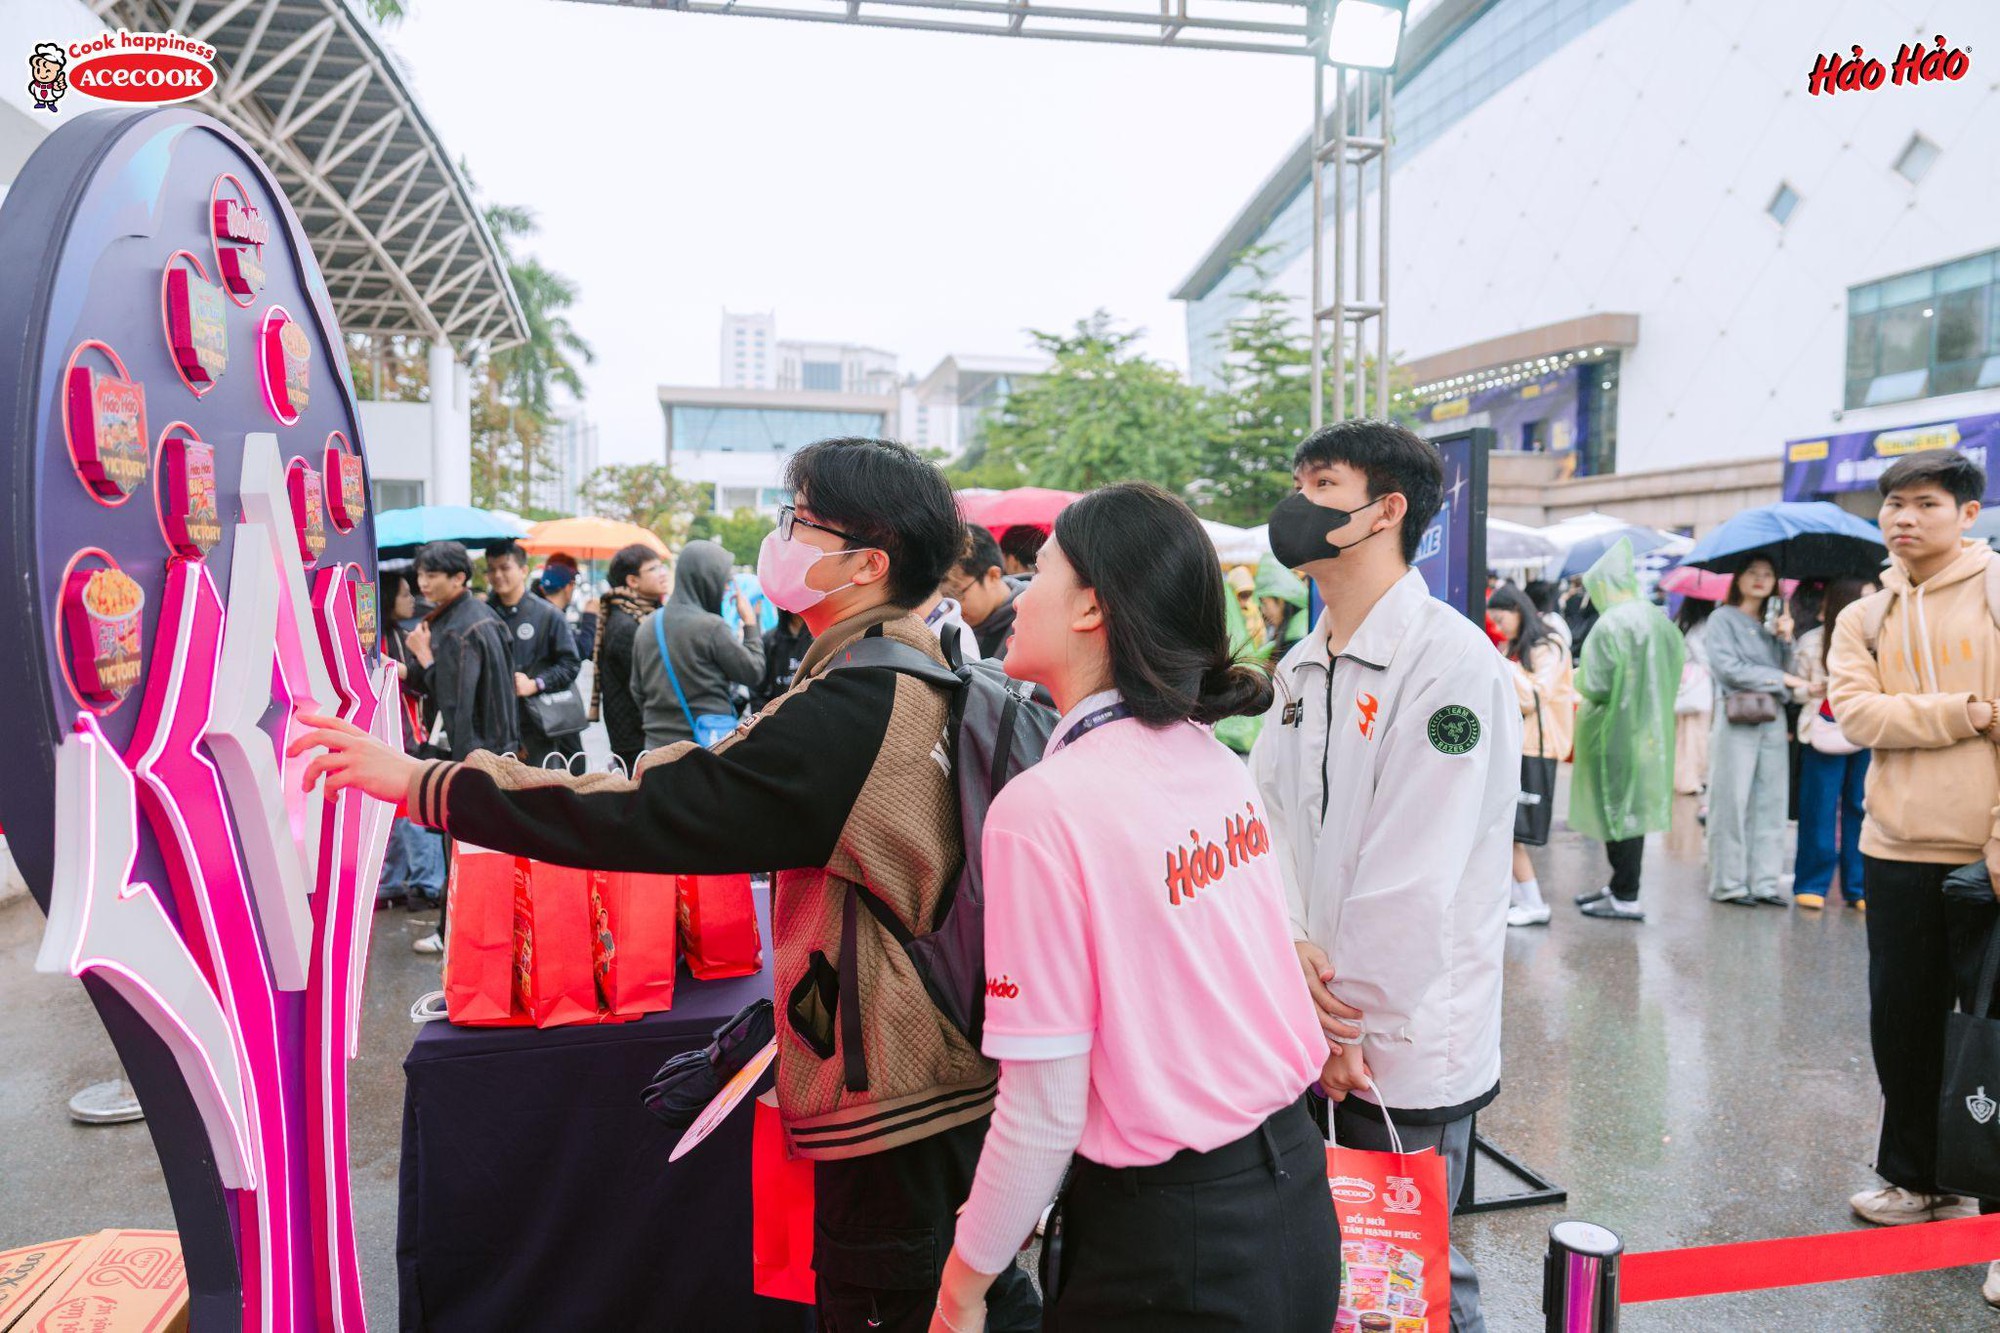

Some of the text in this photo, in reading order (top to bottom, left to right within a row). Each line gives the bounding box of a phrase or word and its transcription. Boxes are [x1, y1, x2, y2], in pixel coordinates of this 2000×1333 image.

[102, 456, 146, 479] VICTORY
[187, 524, 221, 542] VICTORY
[98, 659, 142, 684] VICTORY
[1446, 708, 1469, 717] TEAM
[1437, 742, 1464, 752] RAZER
[1165, 829, 1225, 905] Hảo
